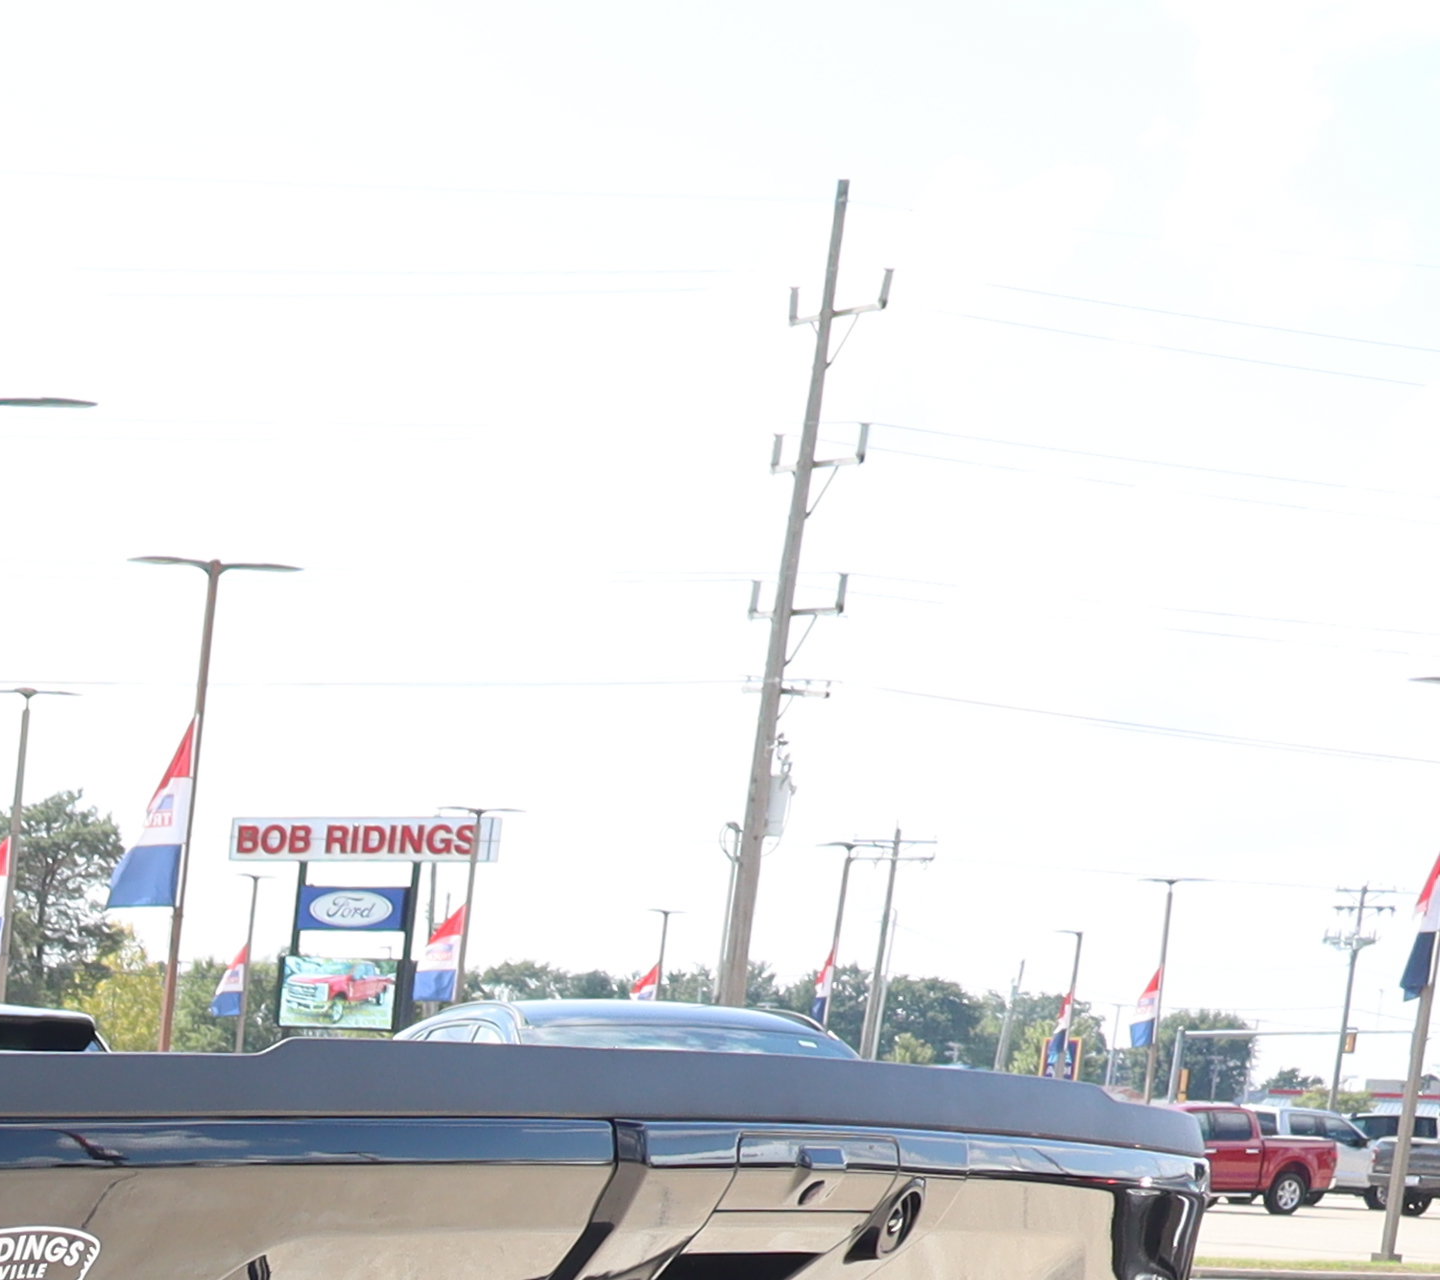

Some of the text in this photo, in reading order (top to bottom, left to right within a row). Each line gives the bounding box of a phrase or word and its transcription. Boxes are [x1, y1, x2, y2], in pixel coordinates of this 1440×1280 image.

[236, 824, 478, 855] BOB RIDINGS
[326, 896, 375, 919] Ford
